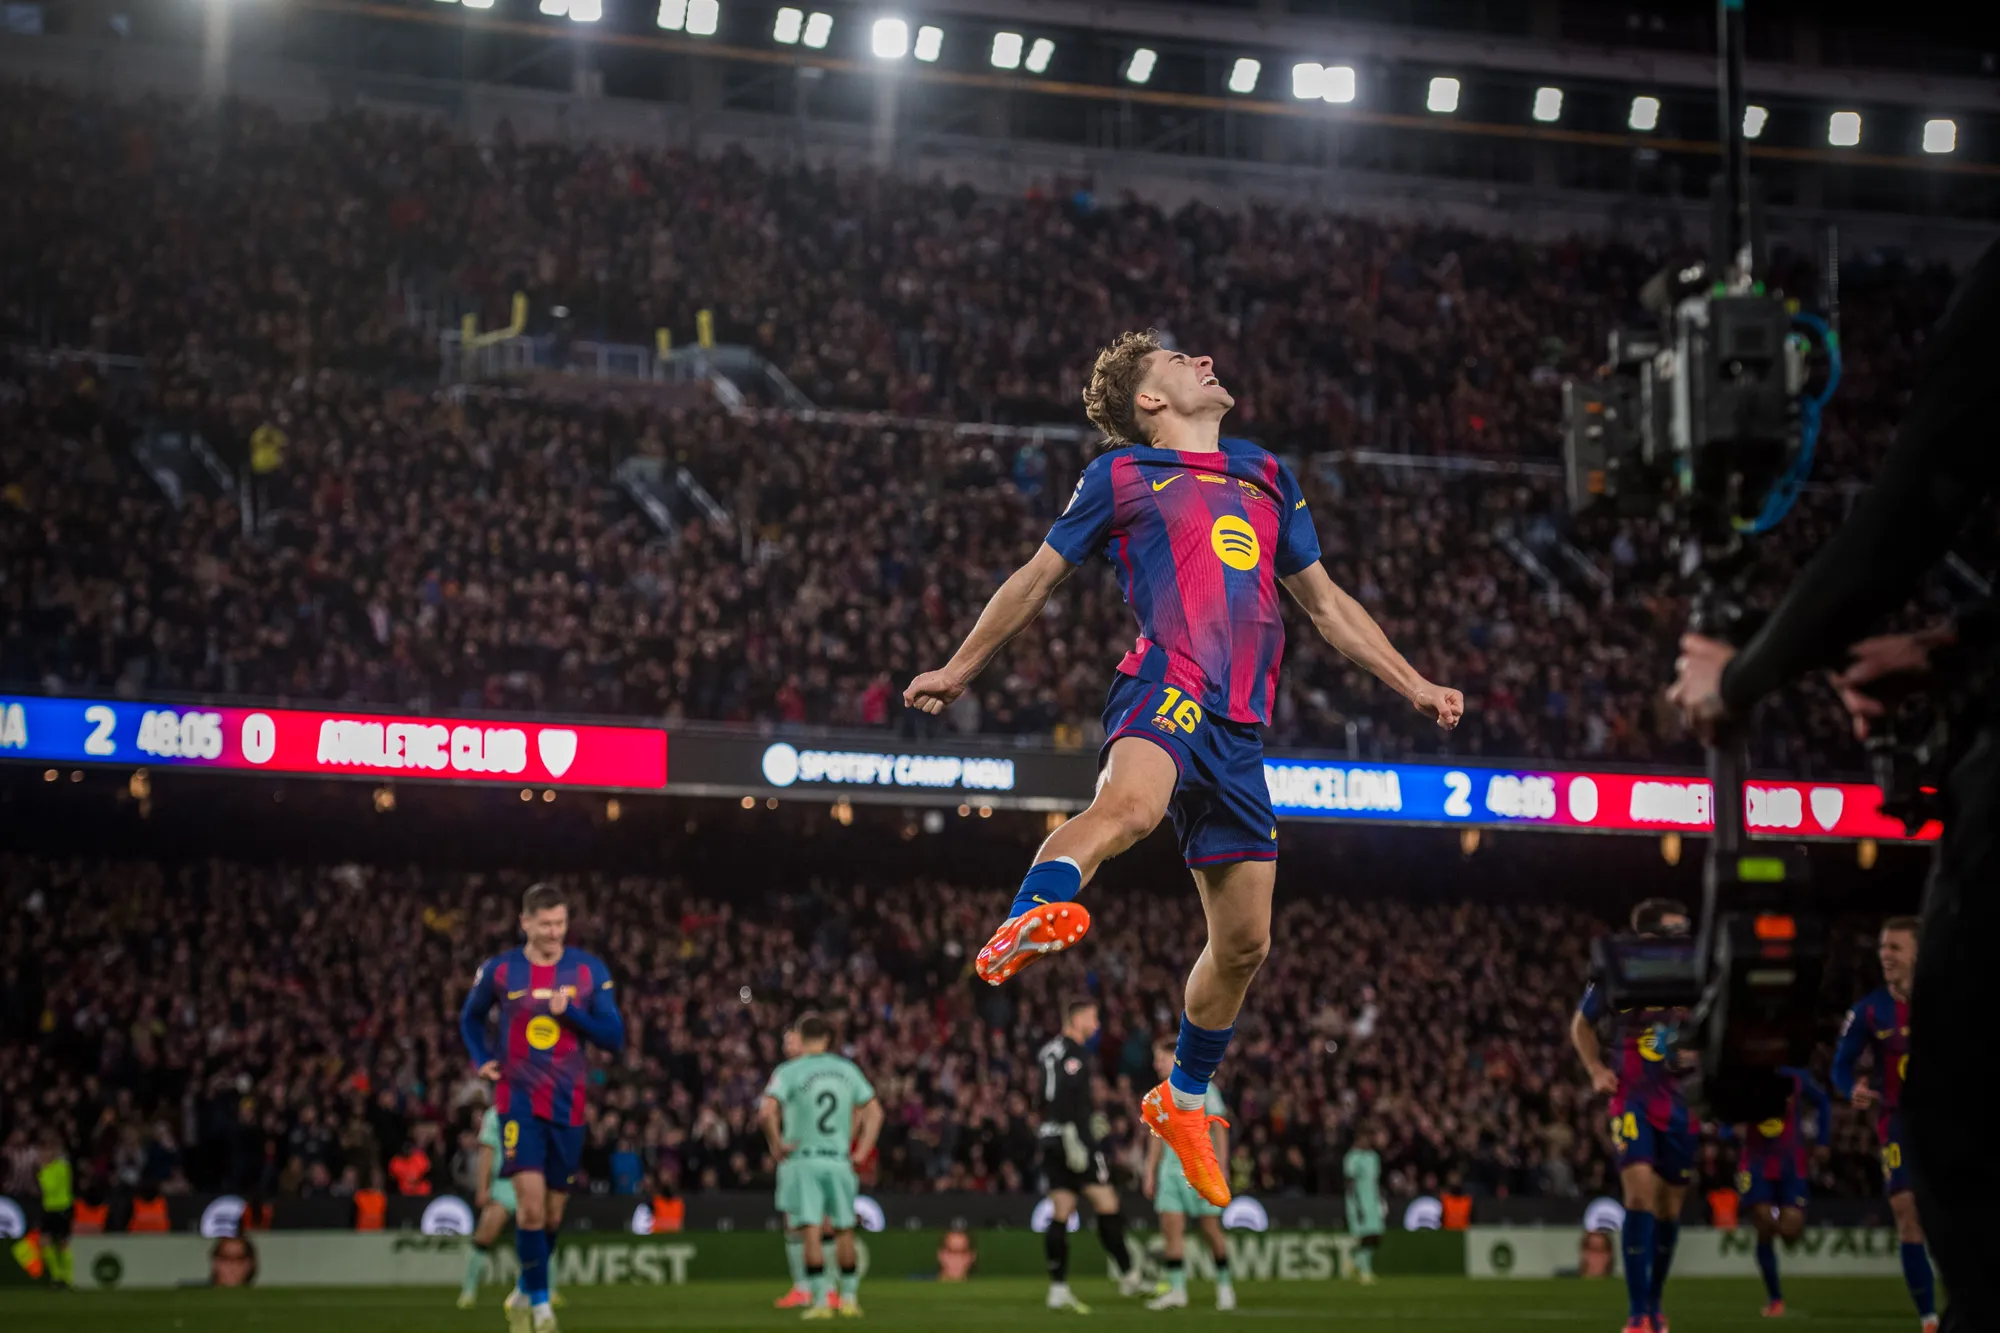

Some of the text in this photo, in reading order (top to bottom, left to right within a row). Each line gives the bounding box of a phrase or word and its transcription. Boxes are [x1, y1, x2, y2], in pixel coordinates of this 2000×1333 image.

[1156, 687, 1202, 734] 16
[84, 705, 116, 755] 2
[137, 710, 223, 760] 48:05
[241, 713, 275, 764] 0
[451, 726, 527, 773] CLUB
[1444, 771, 1472, 817] 2
[1568, 776, 1599, 822] 0
[504, 1120, 519, 1148] 9
[815, 1089, 838, 1135] 2
[555, 1243, 697, 1286] WEST
[1226, 1233, 1361, 1281] WEST
